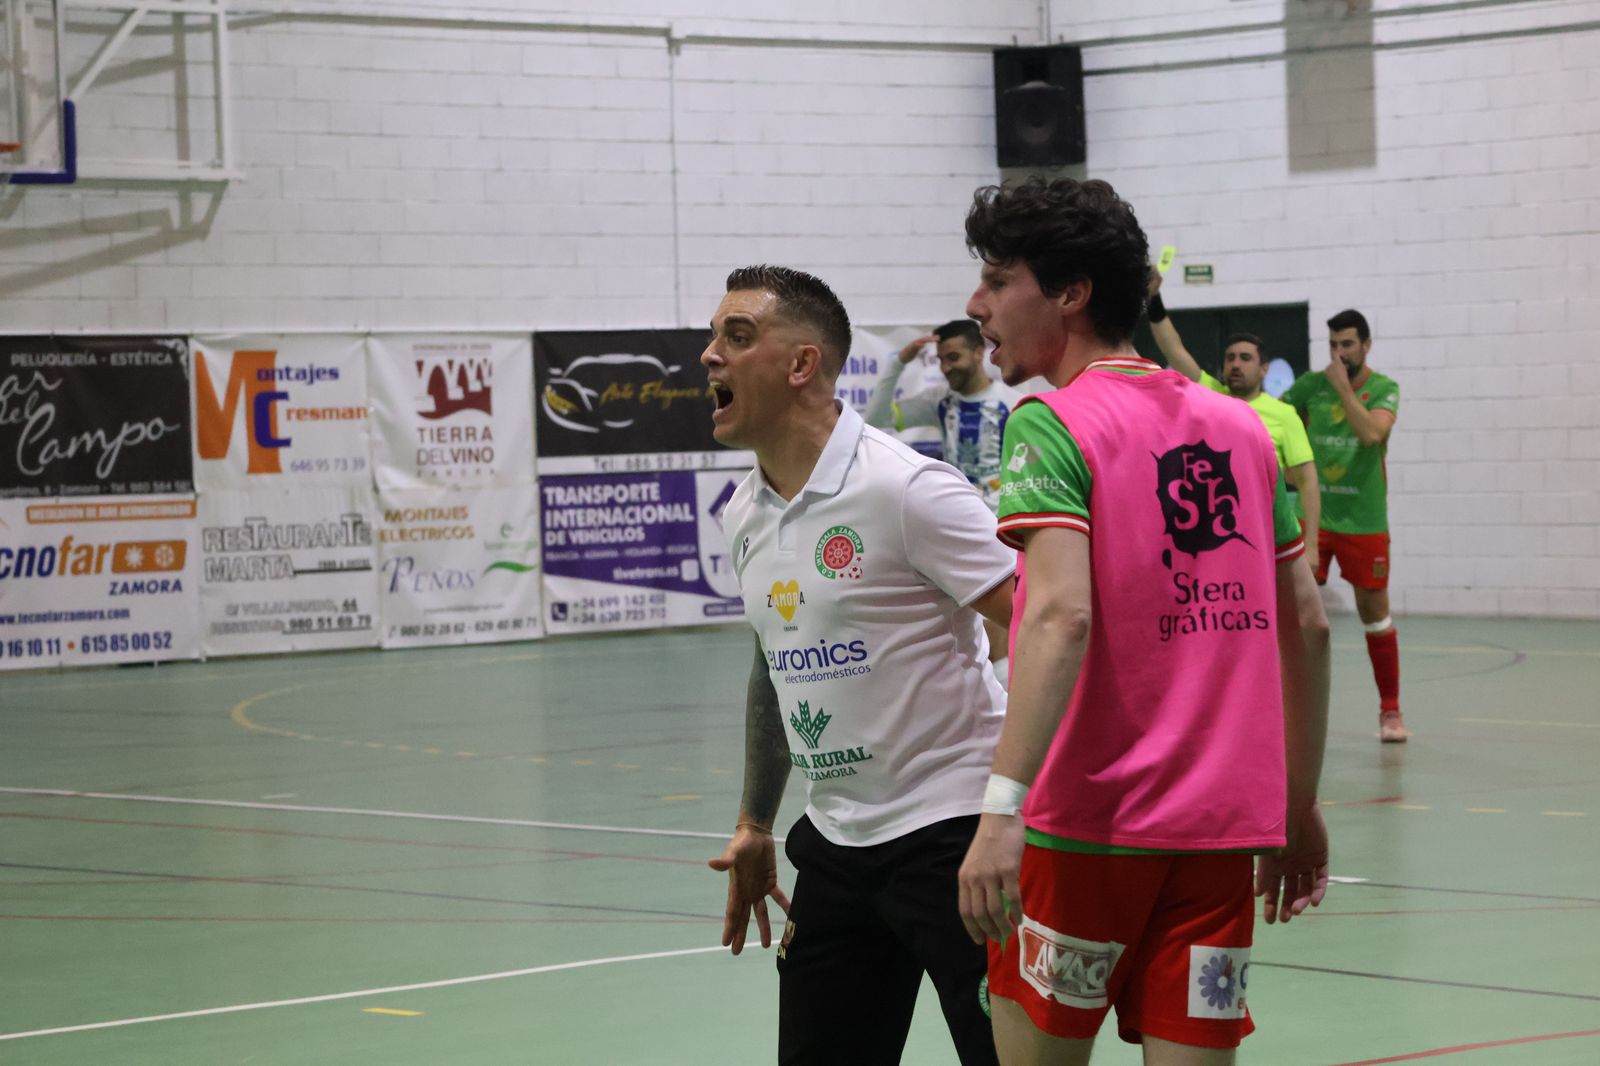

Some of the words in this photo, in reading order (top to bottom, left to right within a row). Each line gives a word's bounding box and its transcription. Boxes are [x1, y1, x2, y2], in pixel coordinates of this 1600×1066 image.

[110, 351, 174, 366] ESTÉTICA
[17, 402, 181, 479] Campo
[416, 426, 494, 443] TIERRA
[544, 482, 660, 505] TRANSPORTE
[384, 506, 469, 523] MONTAJES
[545, 503, 694, 528] INTERNACIONAL
[545, 531, 566, 546] DE
[204, 554, 297, 583] MARTA
[109, 579, 183, 596] ZAMORA
[1173, 572, 1246, 605] Sfera
[767, 591, 806, 608] ZAMORA
[1159, 606, 1270, 642] gráficas
[28, 638, 43, 657] 10
[47, 637, 61, 656] 11
[153, 631, 172, 649] 52
[784, 664, 872, 685] electrodomésticos
[810, 745, 873, 769] RURAL
